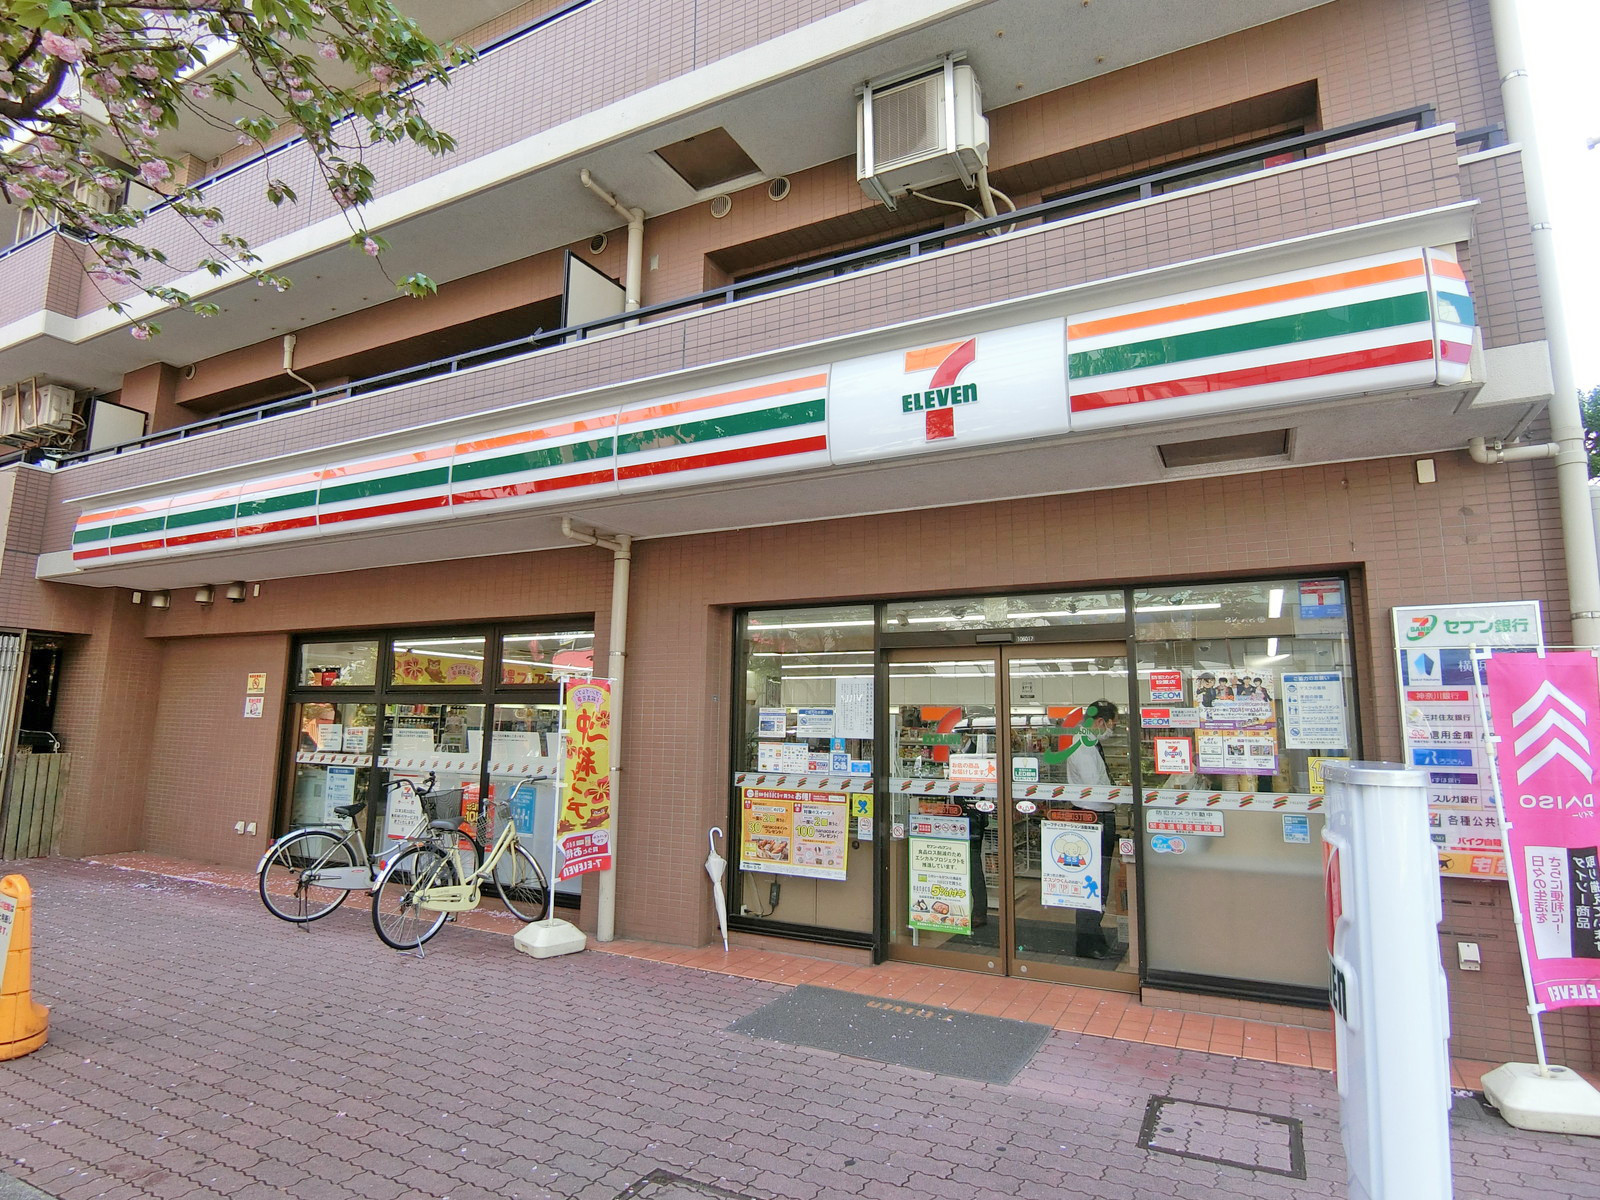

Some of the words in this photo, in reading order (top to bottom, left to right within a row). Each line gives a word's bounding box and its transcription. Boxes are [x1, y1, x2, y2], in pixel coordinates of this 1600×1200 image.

[1444, 618, 1529, 634] セブン銀行
[1152, 692, 1181, 700] SECOM
[1416, 692, 1459, 700] 神奈川銀行
[1142, 718, 1170, 726] SECOM
[1430, 730, 1473, 740] 信用金庫
[1433, 795, 1478, 804] スルガ銀行
[1448, 815, 1500, 828] 各種公共
[795, 825, 815, 838] 100
